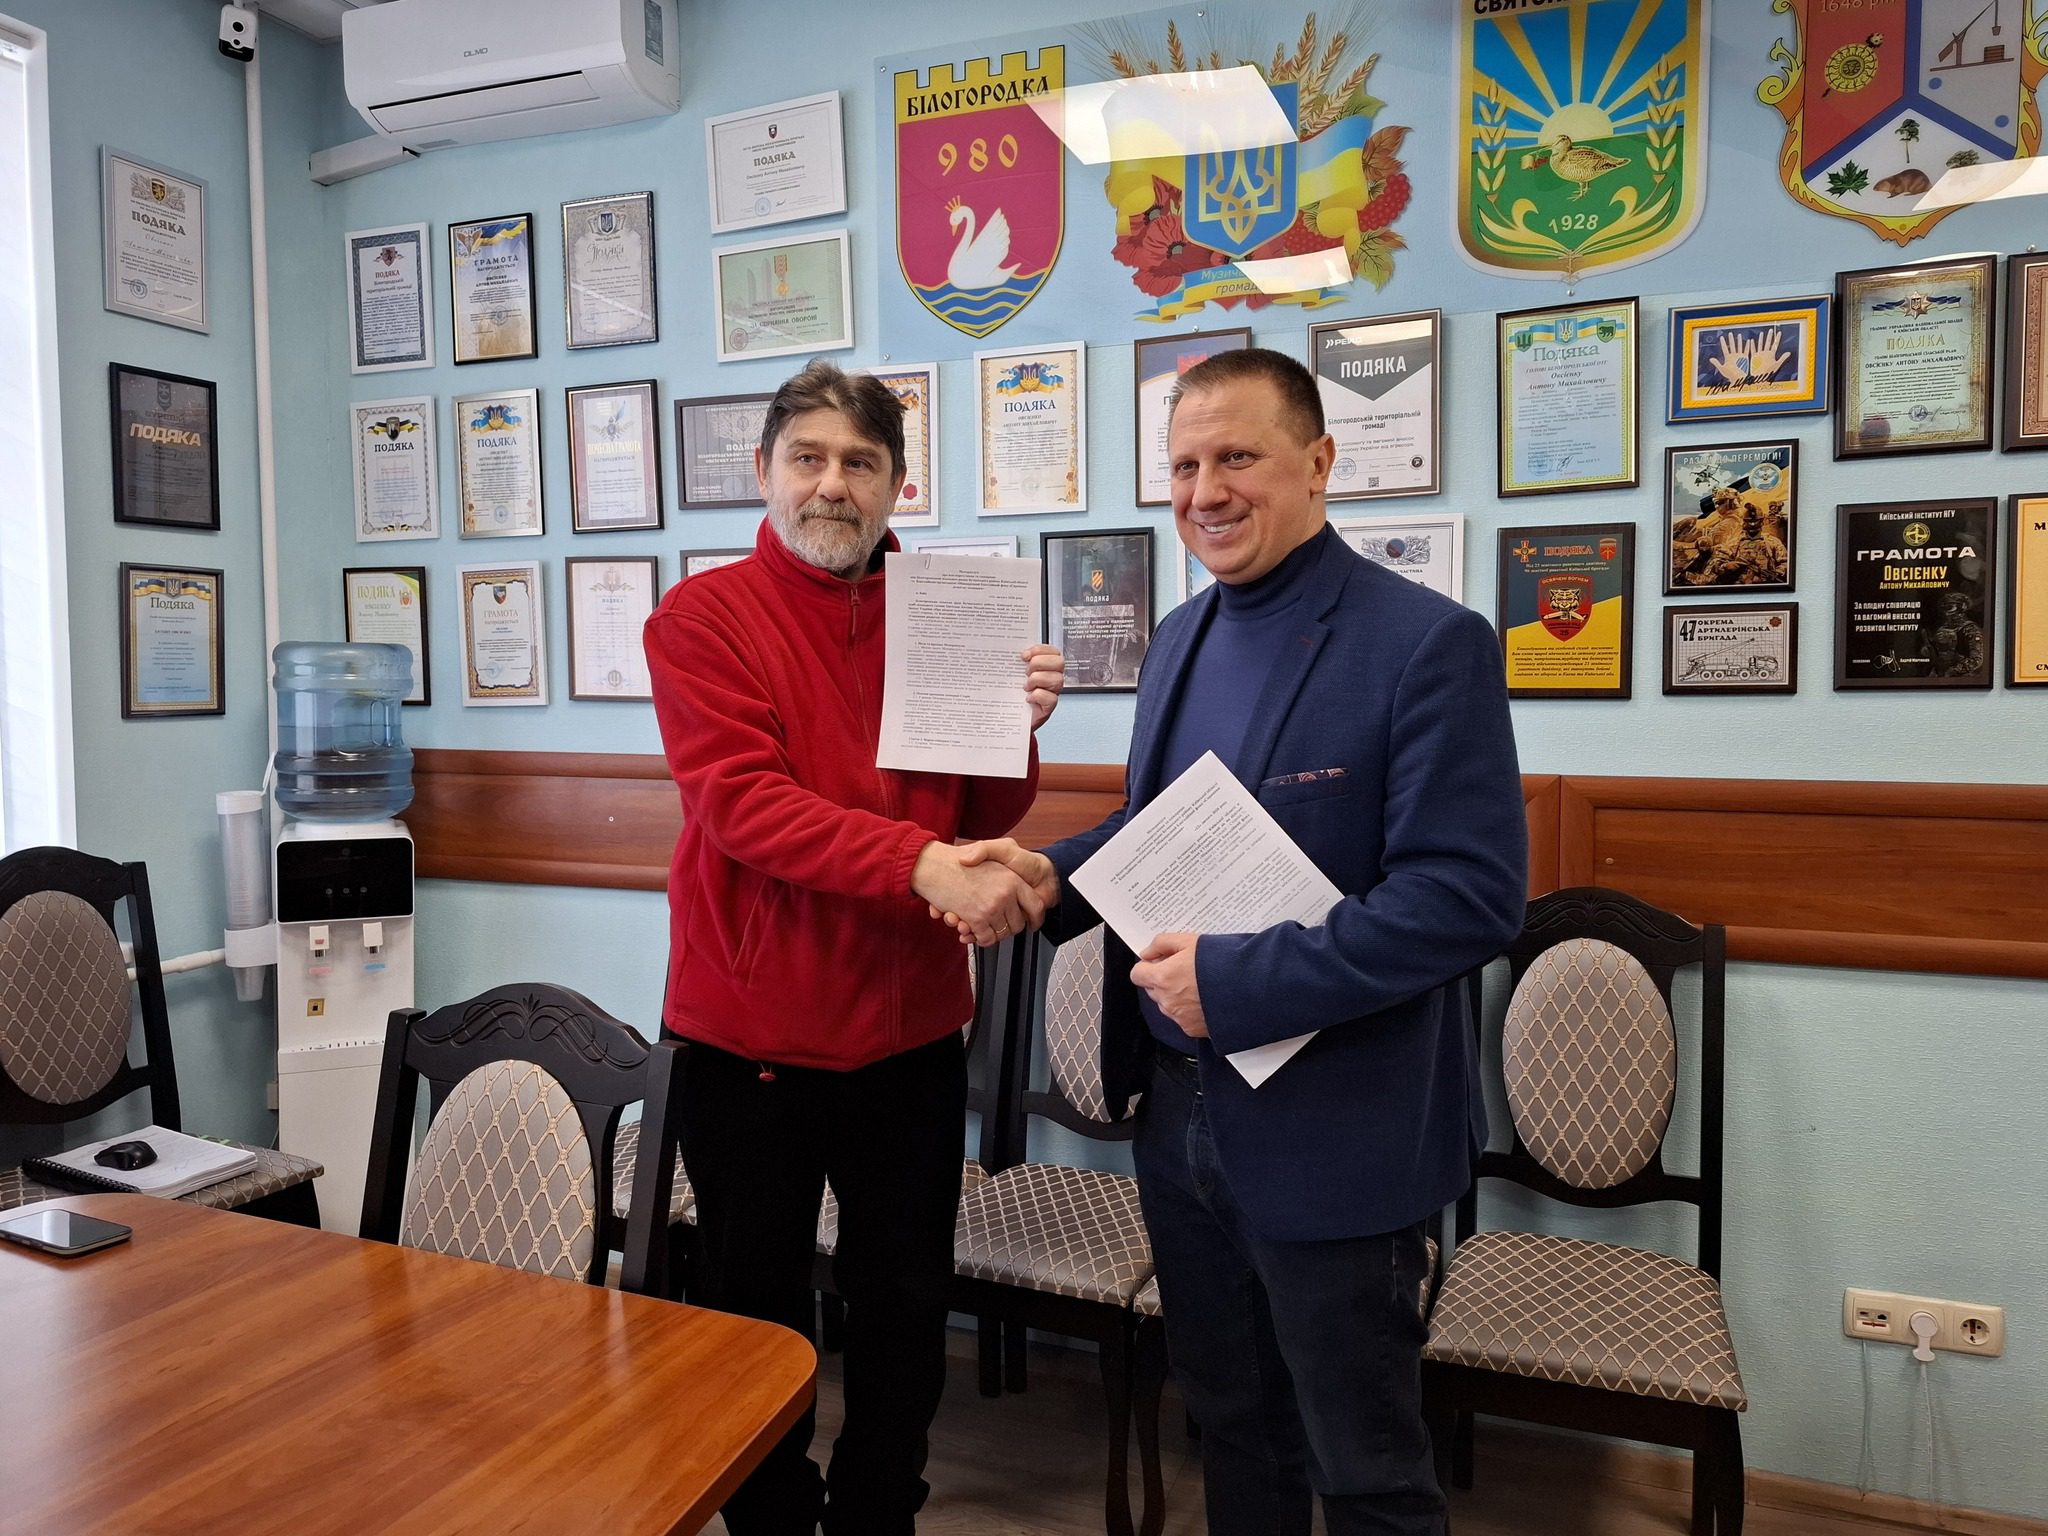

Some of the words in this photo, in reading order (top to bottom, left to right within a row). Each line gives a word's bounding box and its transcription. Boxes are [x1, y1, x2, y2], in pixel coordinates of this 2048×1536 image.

[907, 76, 1050, 117] БІЛОГОРОДКА
[753, 151, 796, 167] ПОДЯКА
[938, 134, 1019, 177] 980
[131, 210, 187, 236] ПОДЯКА
[1548, 213, 1599, 234] 1928
[474, 254, 519, 267] ГРАМОТА
[375, 269, 400, 278] ПОДЯКА
[1886, 333, 1946, 350] ПОДЯКА
[1533, 345, 1600, 362] Подяка
[1341, 356, 1407, 378] ПОДЯКА
[1004, 400, 1056, 413] ПОДЯКА
[1361, 422, 1386, 431] громаді
[129, 422, 202, 447] ПОДЯКА
[374, 441, 414, 452] ПОДЯКА
[477, 436, 517, 448] ПОДЯКА
[726, 443, 761, 452] ПОДЯК
[1731, 451, 1782, 463] ПЕРЕМОГИ!
[2034, 521, 2048, 531] М
[1544, 545, 1594, 558] ПОДЯКА
[1857, 546, 1977, 562] ГРАМОТА
[1884, 565, 1948, 581] ОВСІЄНКУ
[357, 585, 396, 600] ПОДЯКА
[1086, 595, 1109, 603] подяка
[150, 597, 195, 611] Подяка
[484, 609, 519, 618] ГРАМОТА
[1680, 620, 1697, 641] 47
[1697, 626, 1771, 634] АРТИЛЕРІЙСЬКА
